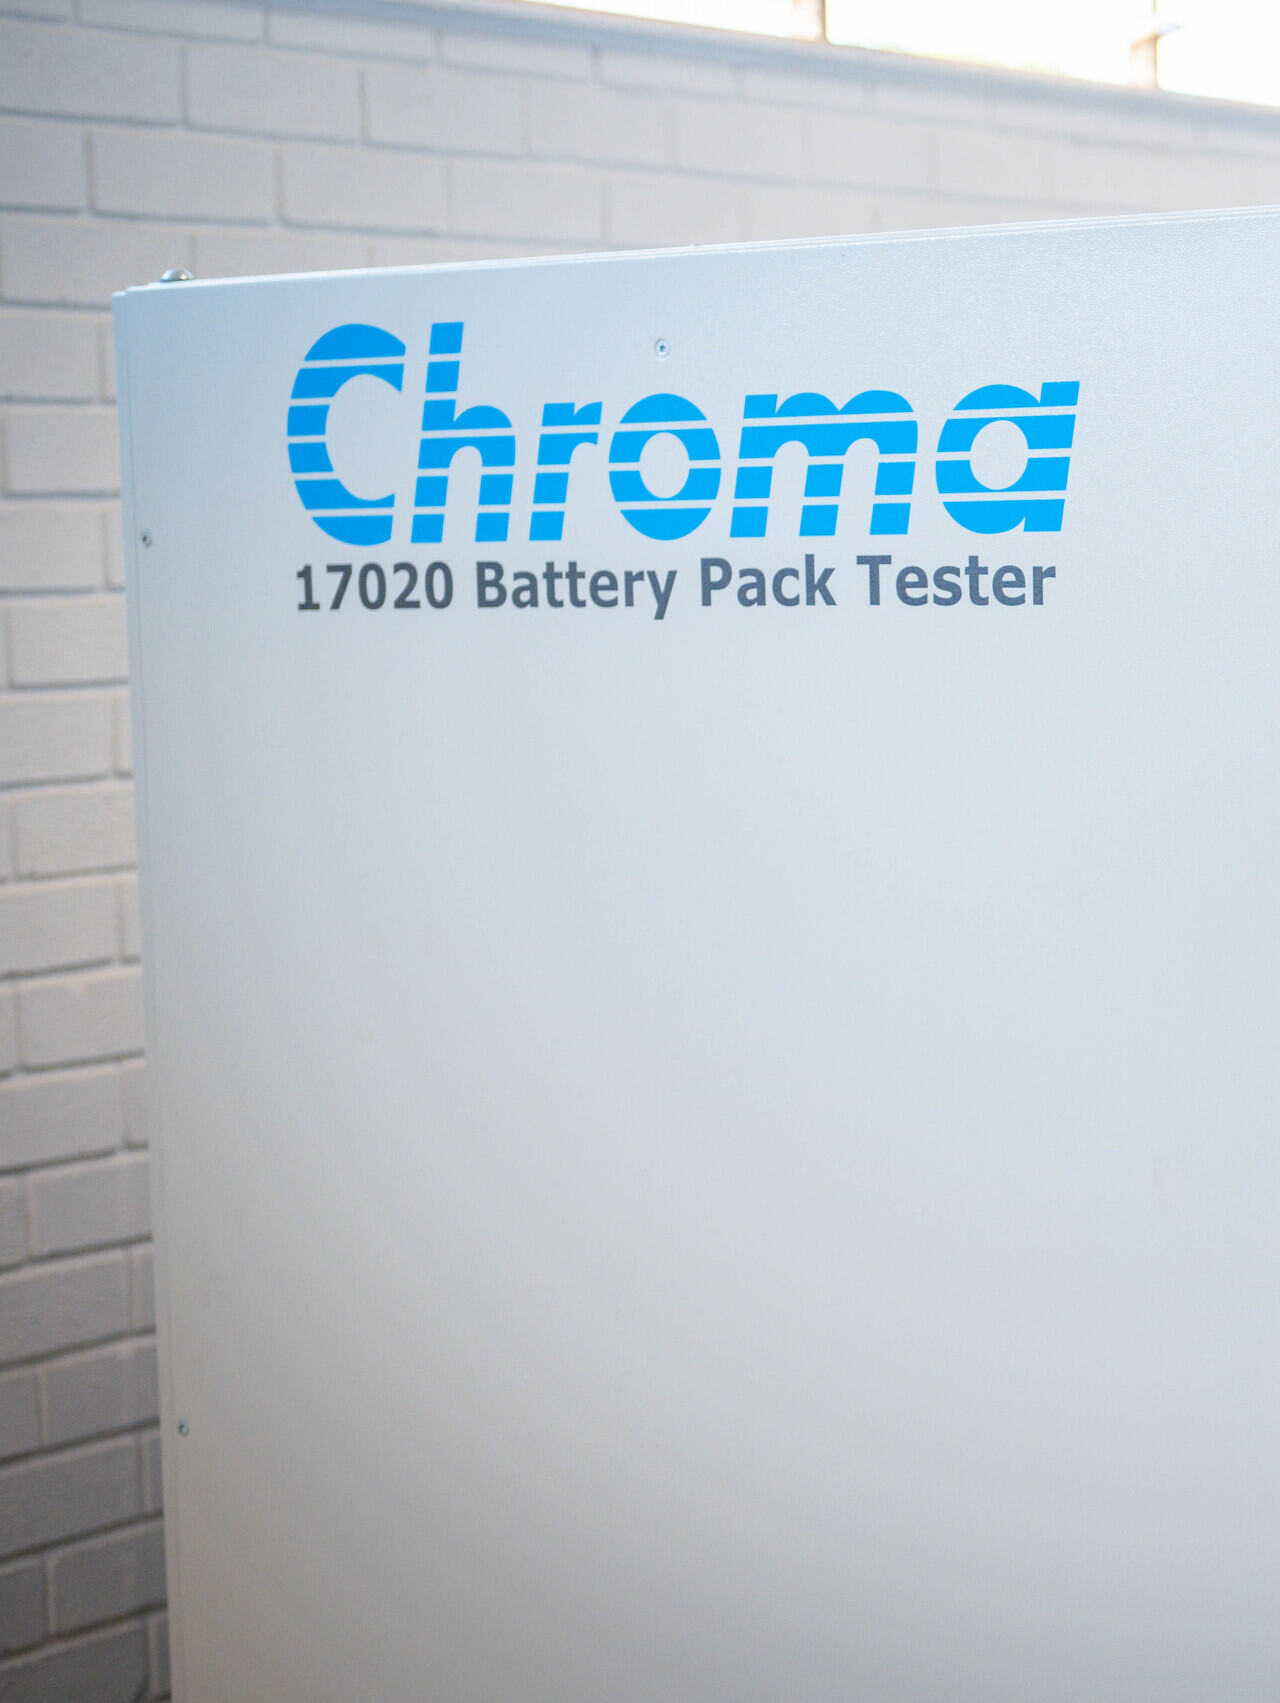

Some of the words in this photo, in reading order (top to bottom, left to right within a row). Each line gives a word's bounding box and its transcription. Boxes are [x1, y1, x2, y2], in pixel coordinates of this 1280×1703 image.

[286, 320, 1081, 547] Chroma
[296, 562, 454, 611] 17020
[476, 561, 678, 620] Battery
[700, 553, 837, 607] Pack
[856, 554, 1056, 607] Tester
